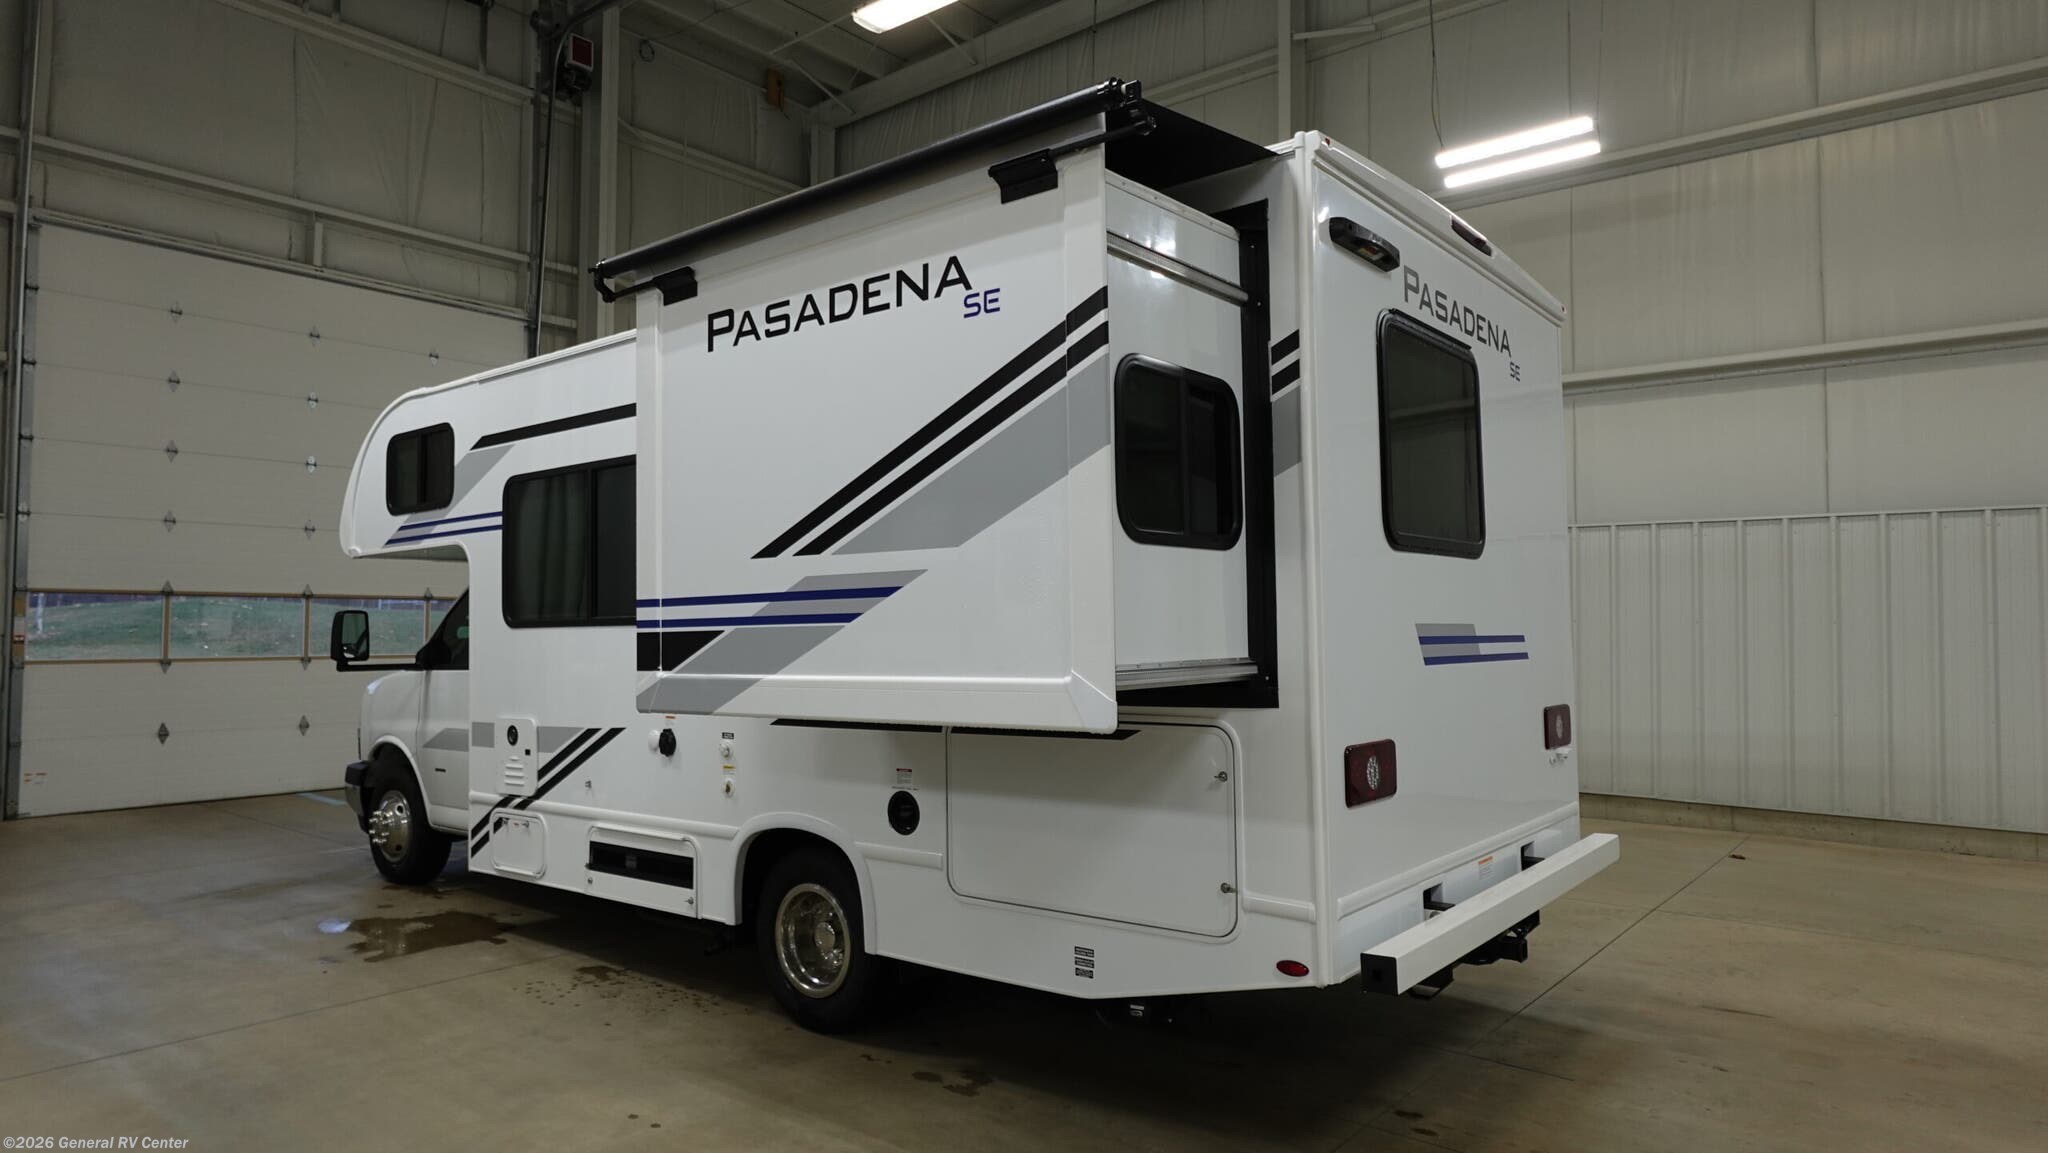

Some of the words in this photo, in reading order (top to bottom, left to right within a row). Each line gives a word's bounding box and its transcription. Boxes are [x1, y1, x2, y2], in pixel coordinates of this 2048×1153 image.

[707, 255, 973, 353] PASADENA
[963, 288, 1001, 318] SE
[1403, 264, 1512, 358] PASADENA
[1509, 361, 1521, 382] SE
